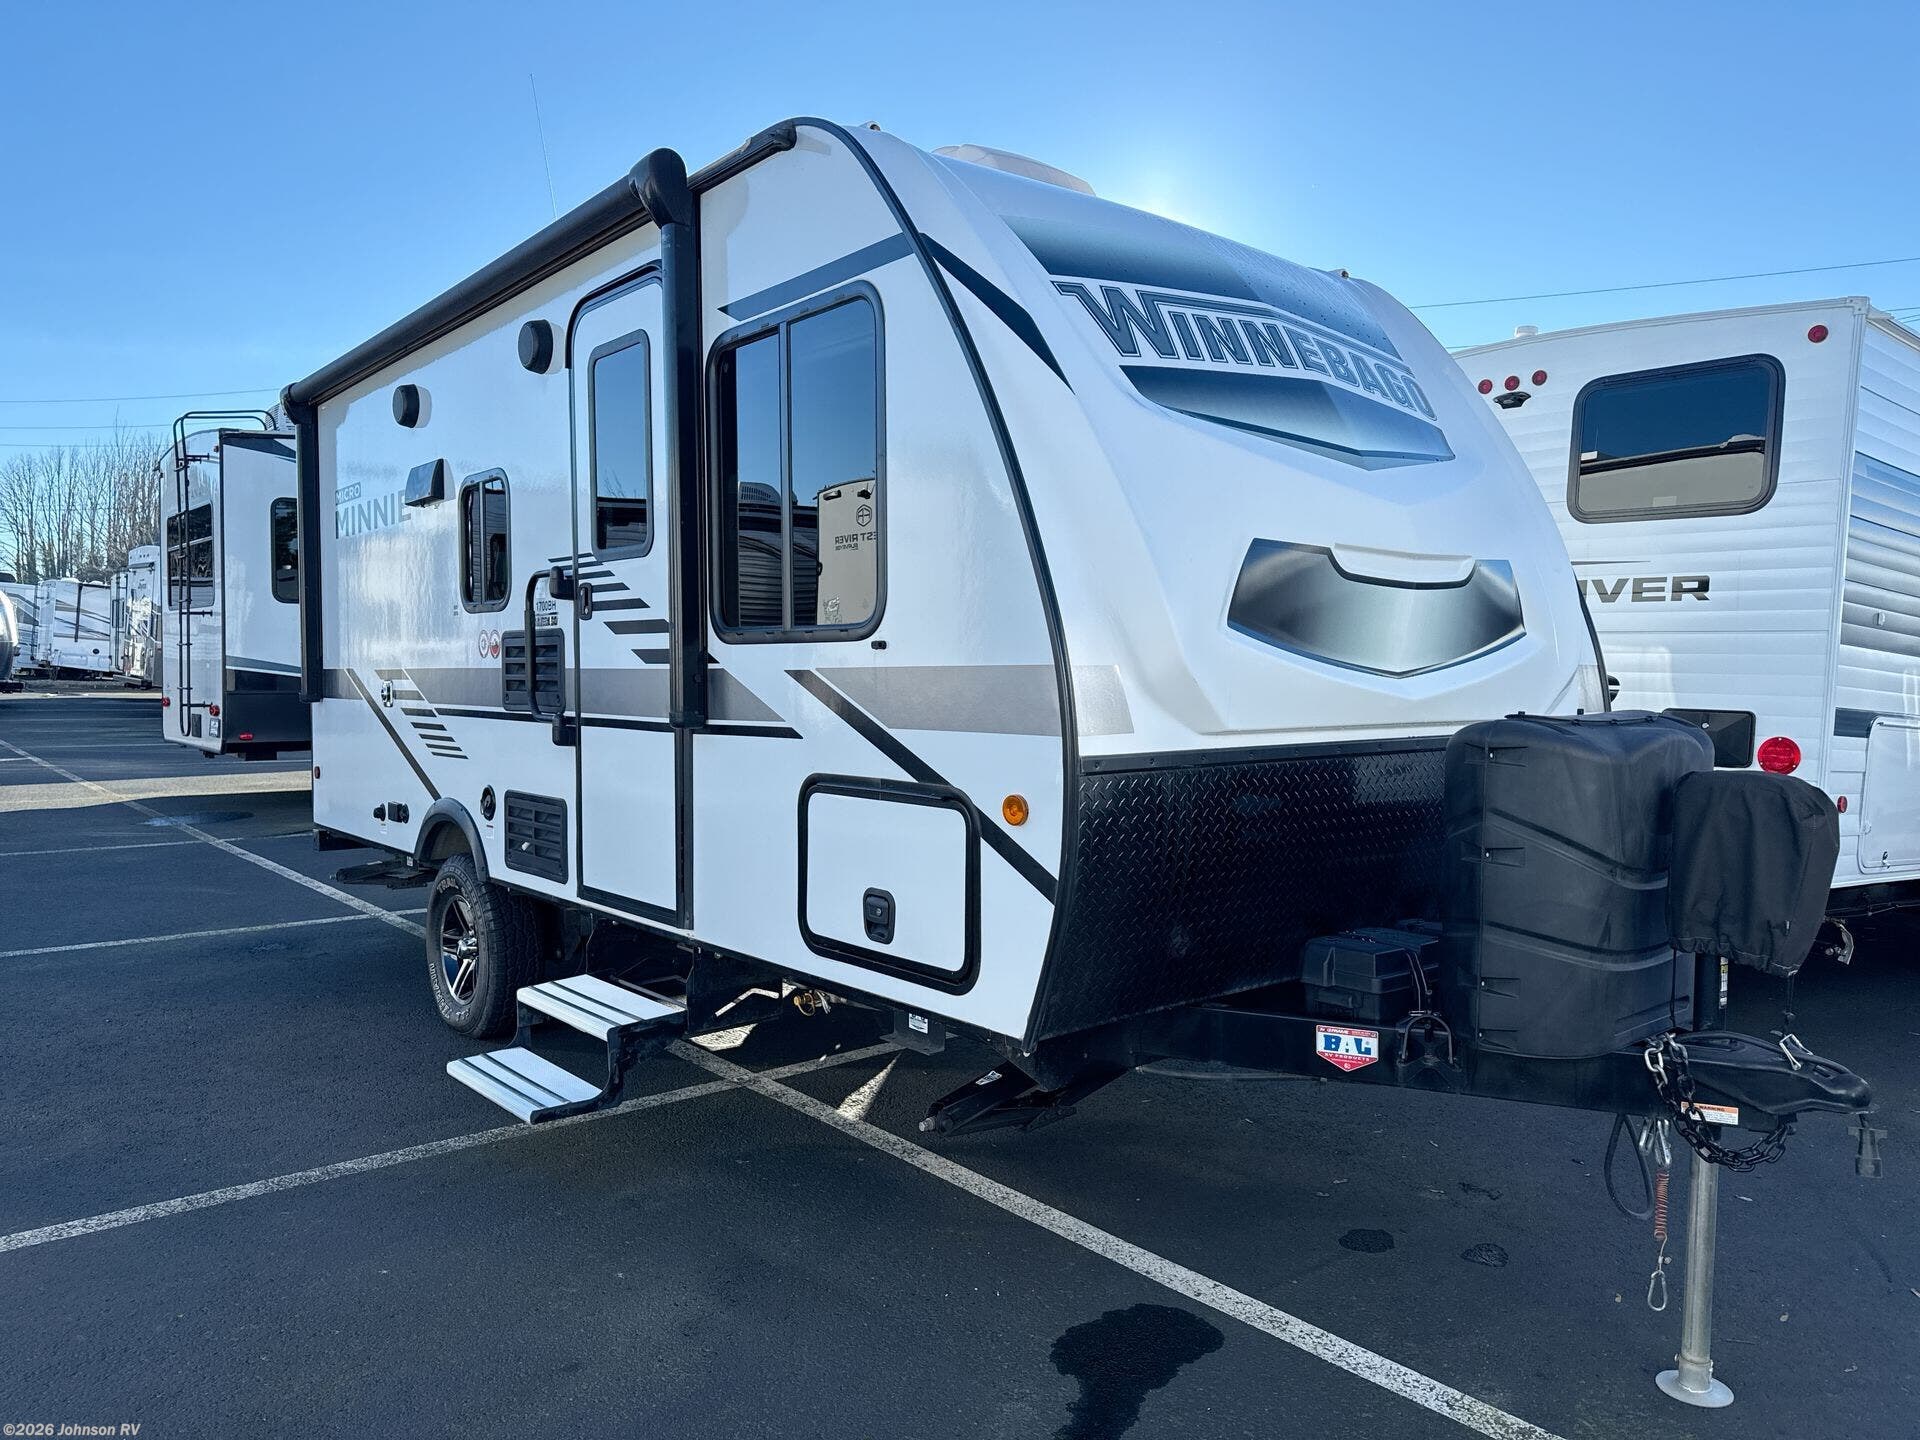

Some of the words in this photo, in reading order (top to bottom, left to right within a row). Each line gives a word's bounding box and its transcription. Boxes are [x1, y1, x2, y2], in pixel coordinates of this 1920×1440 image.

[1051, 281, 1438, 421] WINNEBAGO
[336, 485, 361, 502] MICRO
[335, 489, 412, 539] MINNIE
[1323, 1034, 1372, 1055] BAL
